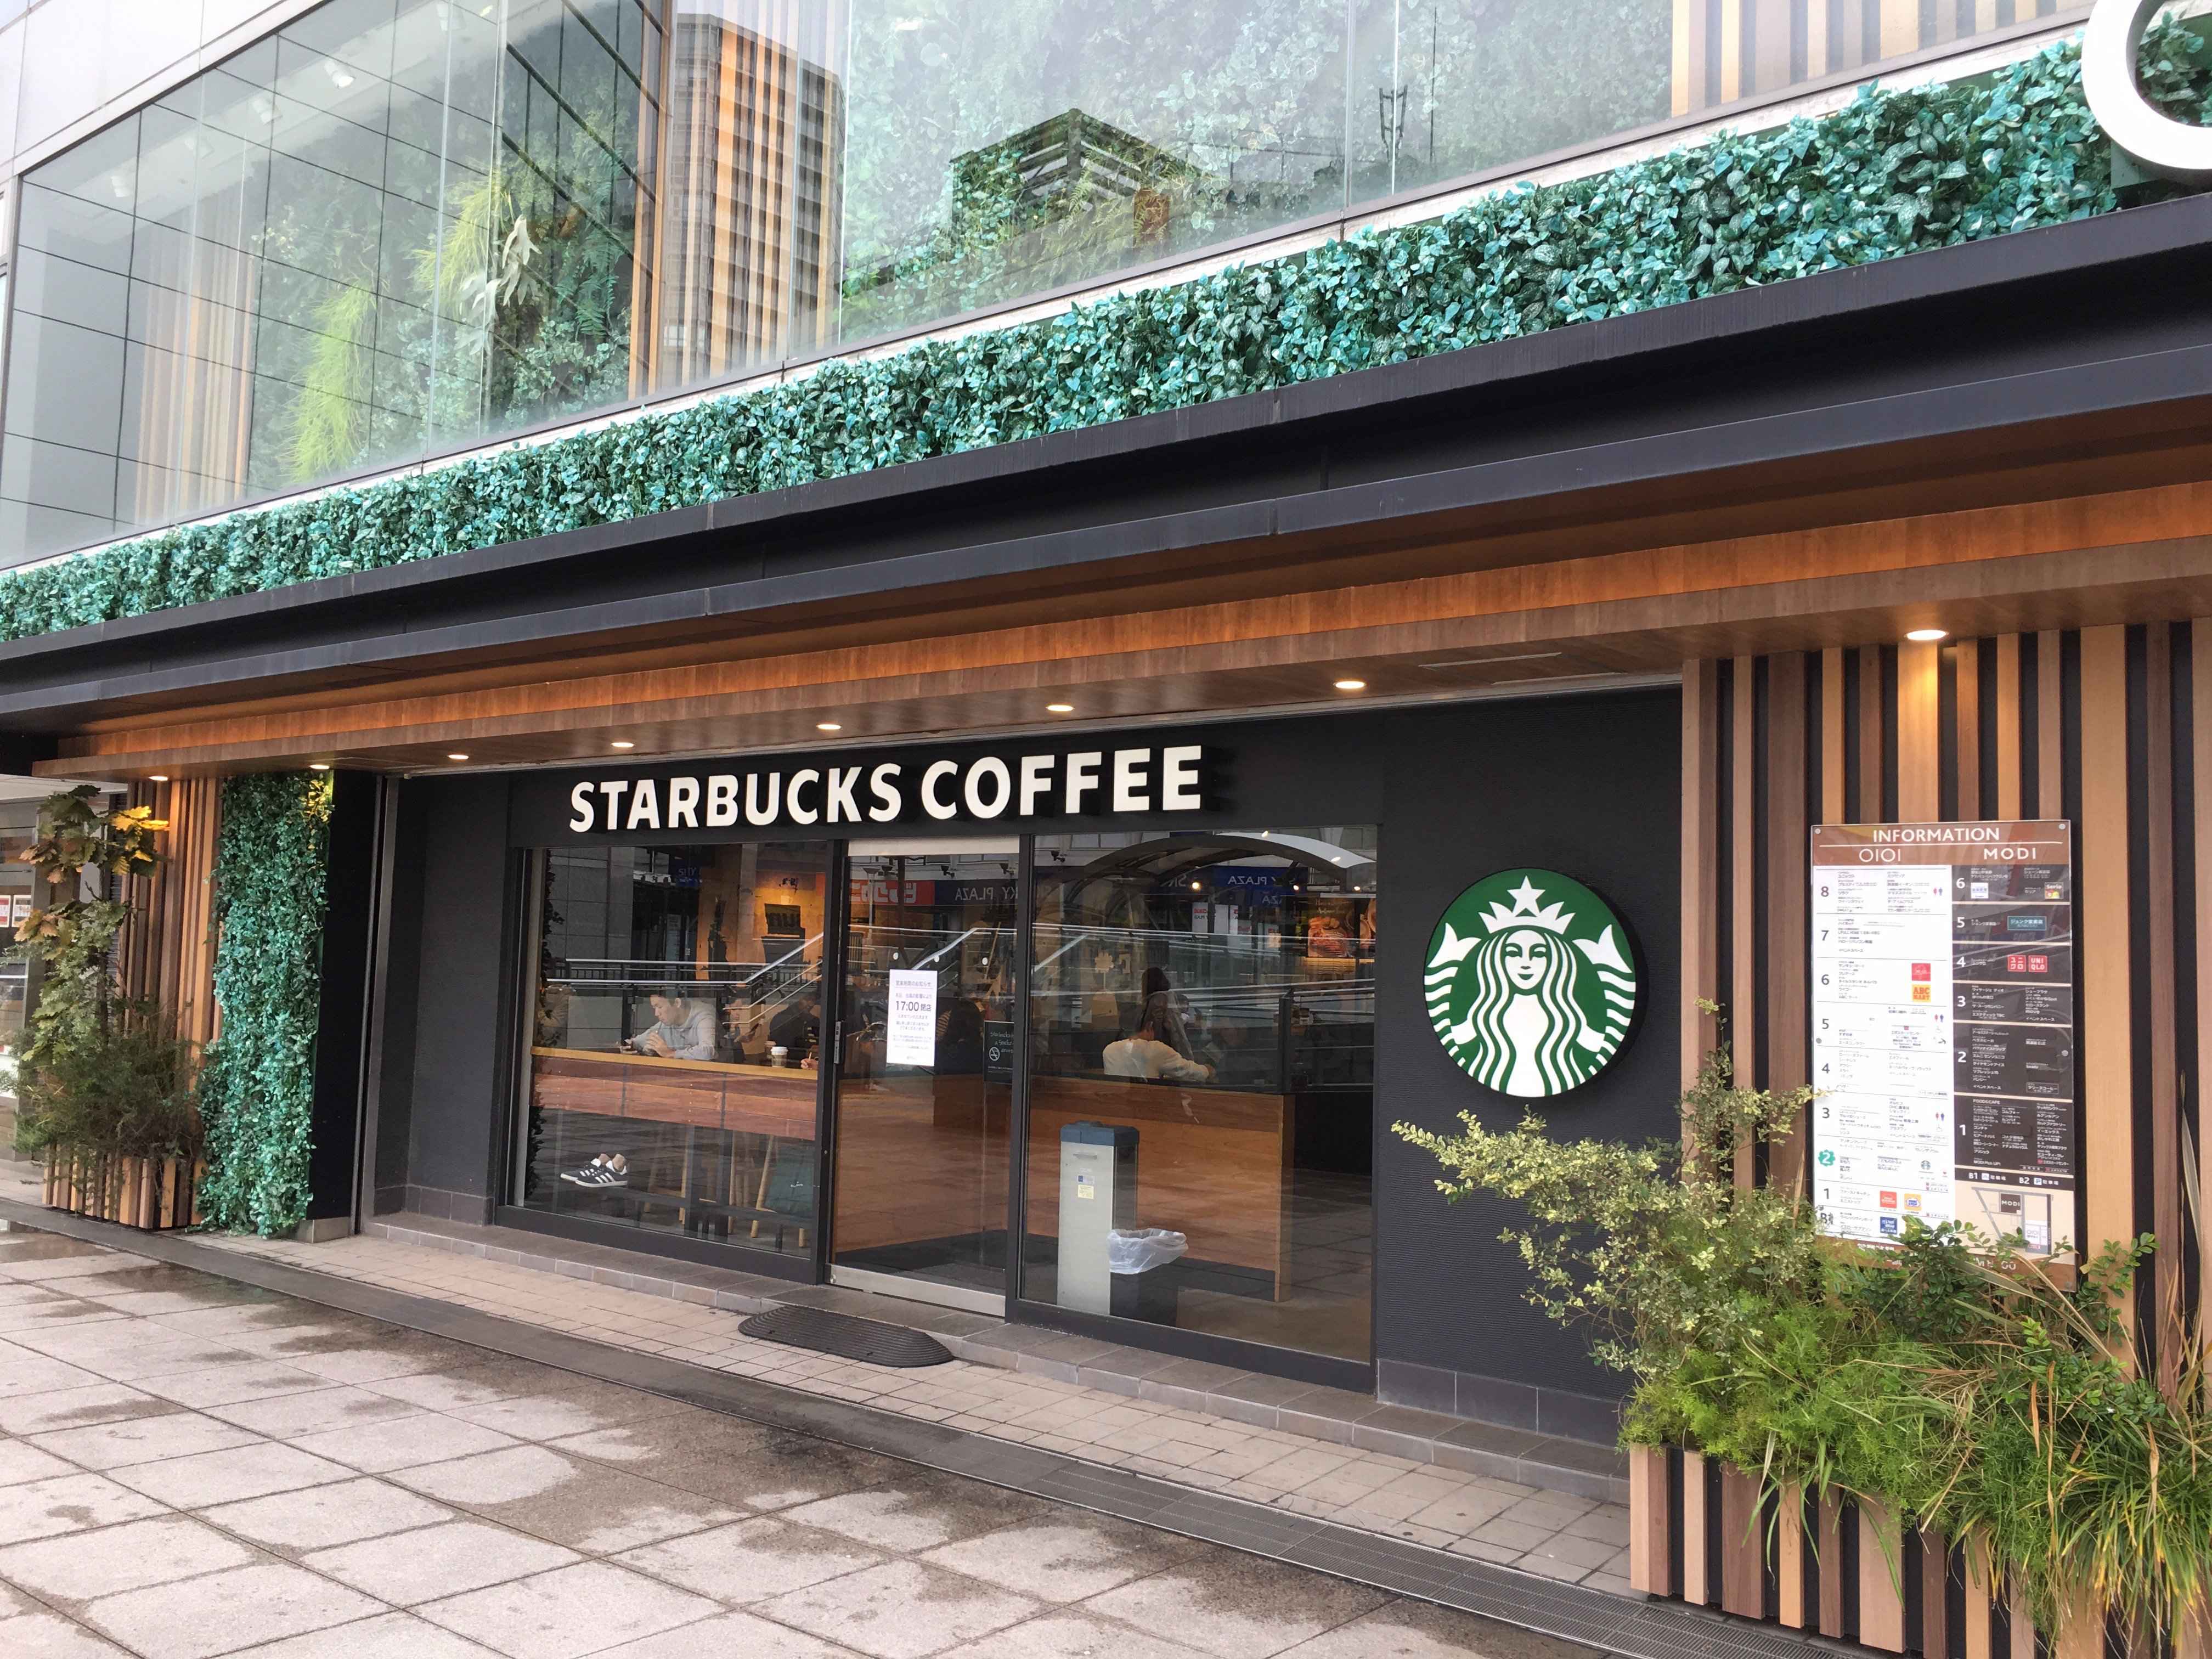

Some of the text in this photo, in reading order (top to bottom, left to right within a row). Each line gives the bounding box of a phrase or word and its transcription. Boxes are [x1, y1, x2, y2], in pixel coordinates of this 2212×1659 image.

[569, 745, 1202, 833] STARBUCKS COFFEE
[1873, 827, 2000, 843] INFORMATION
[1983, 848, 2037, 860] MODI
[1956, 877, 1965, 889] 6
[1820, 886, 1829, 897] 8
[1956, 917, 1965, 928] 5
[1821, 930, 1830, 941] 7
[1956, 956, 1966, 968] 4
[1821, 974, 1830, 985] 6
[895, 1001, 919, 1012] 17:00
[1957, 996, 1966, 1007] 3
[1821, 1018, 1830, 1030] 5
[1957, 1051, 1967, 1063] 2
[1821, 1063, 1830, 1074] 4
[1822, 1107, 1830, 1119] 3
[1959, 1124, 1966, 1136] 1
[1821, 1152, 1831, 1164] 2
[1824, 1188, 1830, 1200] 1
